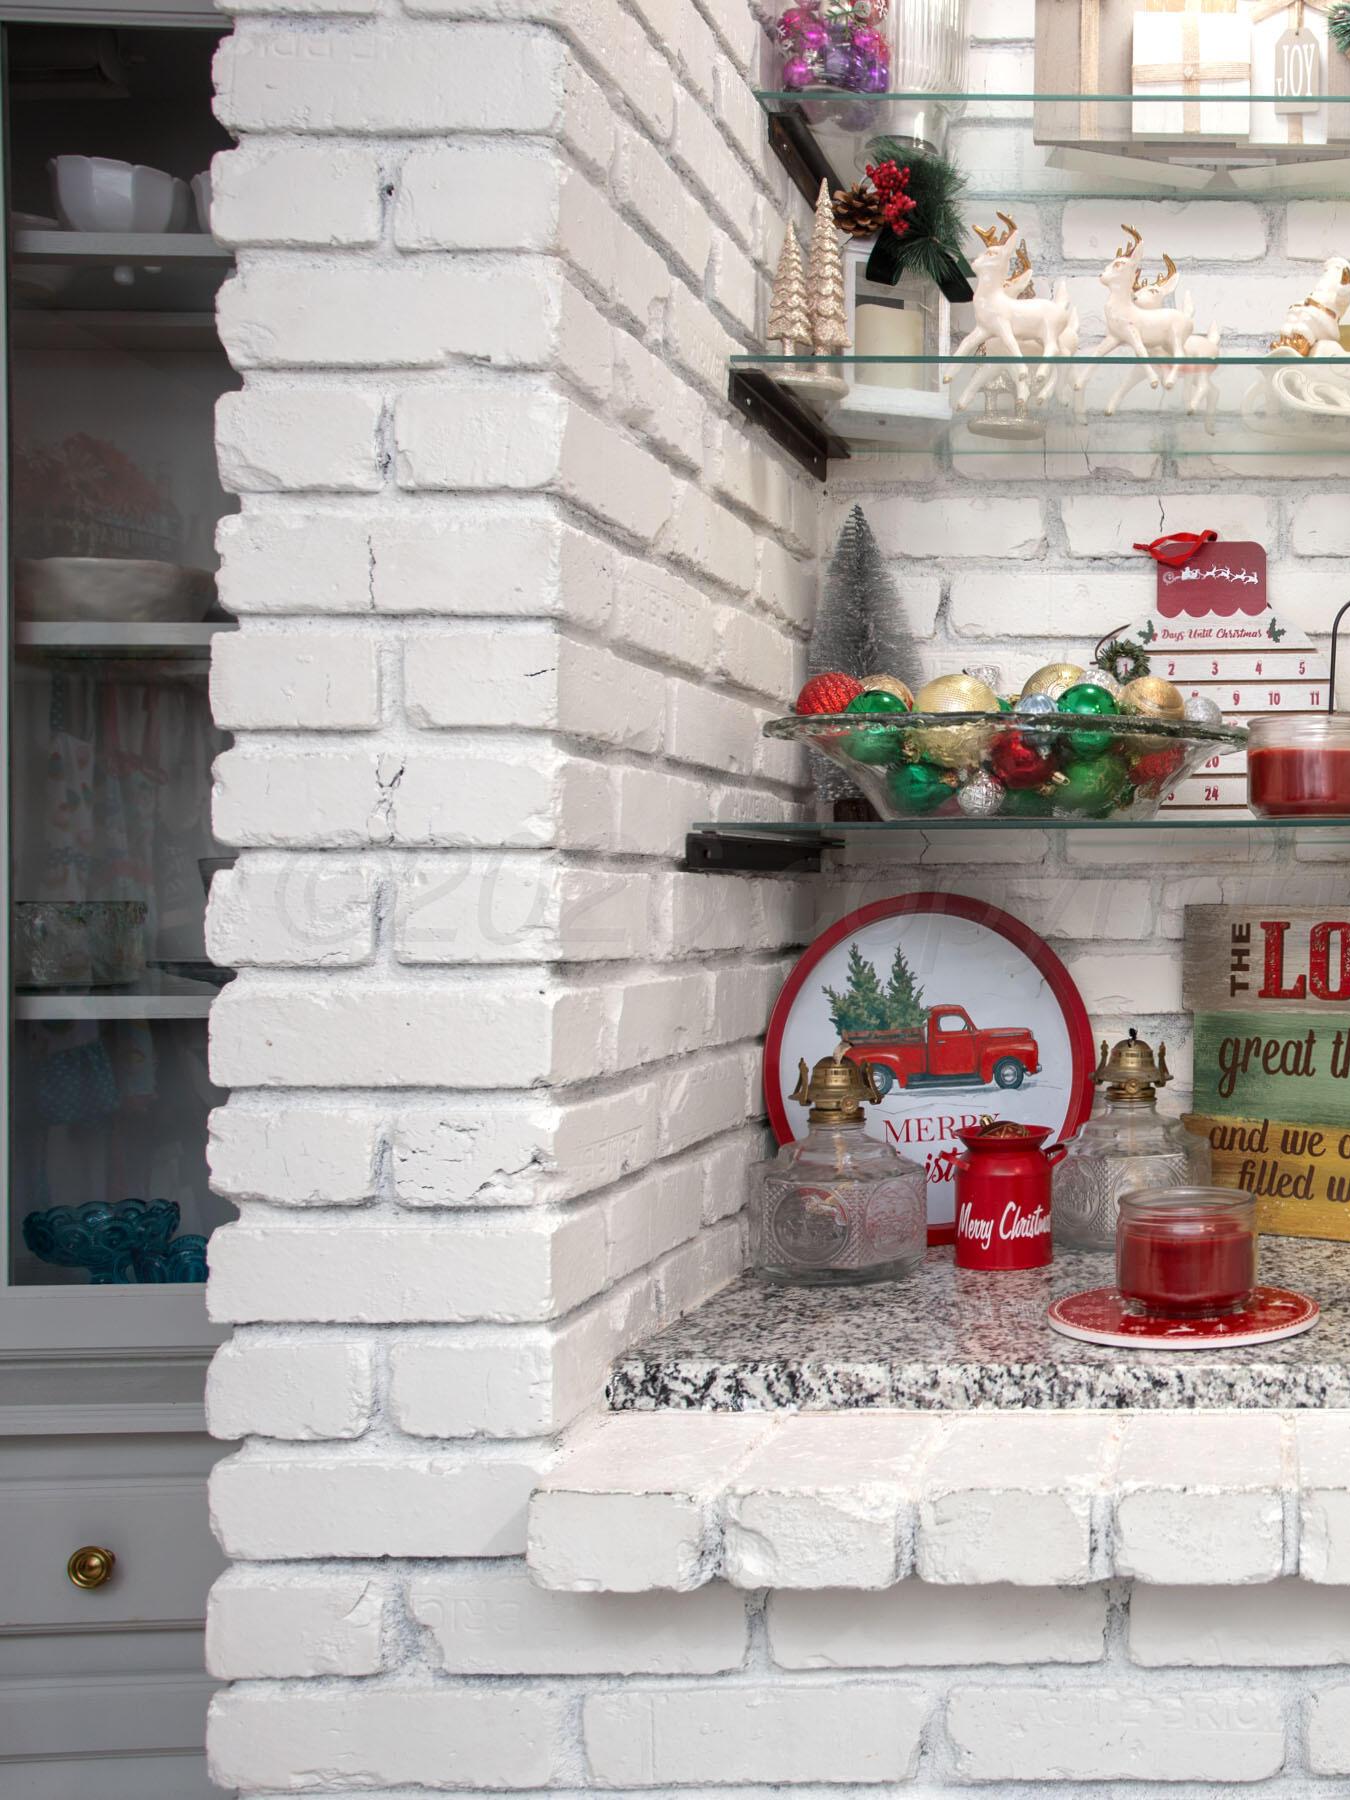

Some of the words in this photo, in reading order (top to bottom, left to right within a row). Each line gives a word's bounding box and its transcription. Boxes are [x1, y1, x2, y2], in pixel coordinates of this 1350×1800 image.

[1276, 44, 1315, 96] JOY
[1162, 628, 1185, 642] Days
[1188, 628, 1213, 639] Until
[1216, 627, 1263, 640] Christmas
[1168, 661, 1176, 676] 2
[1212, 661, 1219, 676] 3
[1255, 661, 1263, 676] 4
[1299, 661, 1306, 675] 5
[1233, 690, 1240, 706] 9
[1268, 691, 1281, 706] 10
[1310, 690, 1320, 706] 11
[1205, 786, 1219, 801] 24
[1230, 922, 1251, 997] THE
[1218, 1029, 1317, 1098] great
[1209, 1118, 1269, 1154] and
[1280, 1127, 1327, 1157] we
[1237, 1158, 1316, 1201] filled
[957, 1201, 995, 1251] Merry
